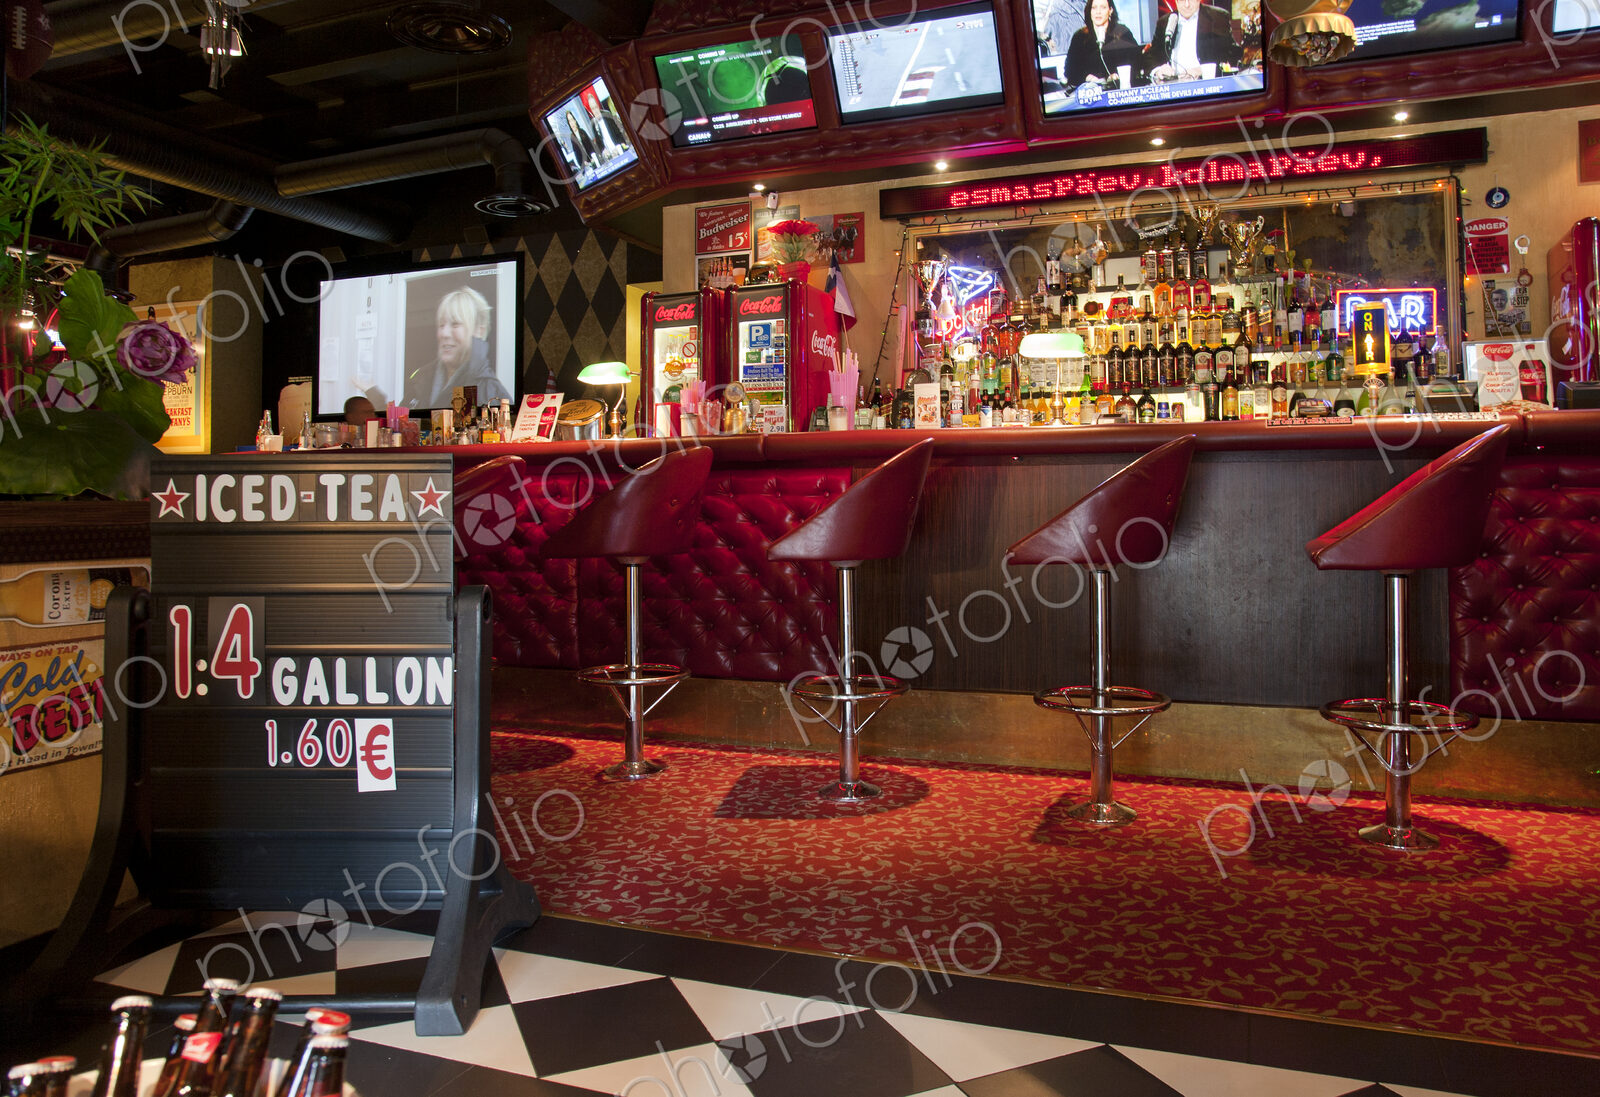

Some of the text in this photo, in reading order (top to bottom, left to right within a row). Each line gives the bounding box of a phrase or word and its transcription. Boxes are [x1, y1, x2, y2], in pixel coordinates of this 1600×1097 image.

[1107, 85, 1170, 99] BETHANY MCLEAN
[1171, 89, 1192, 99] DEVILS
[1192, 87, 1205, 96] ARE
[698, 213, 749, 240] Budweiser
[1464, 221, 1506, 232] DANGER
[654, 302, 696, 323] Coca-Cola
[739, 295, 784, 317] Coca-Cola
[751, 325, 764, 342] P
[165, 407, 192, 417] EAKFAST
[951, 402, 963, 410] HP
[171, 416, 191, 427] FANY'S
[195, 473, 407, 523] ICED-TEA
[62, 580, 72, 610] Extra
[35, 647, 53, 658] ON
[57, 644, 79, 655] TAP
[0, 649, 86, 714] Cold
[271, 656, 452, 706] GALLON
[16, 750, 49, 766] Head
[50, 748, 62, 759] in
